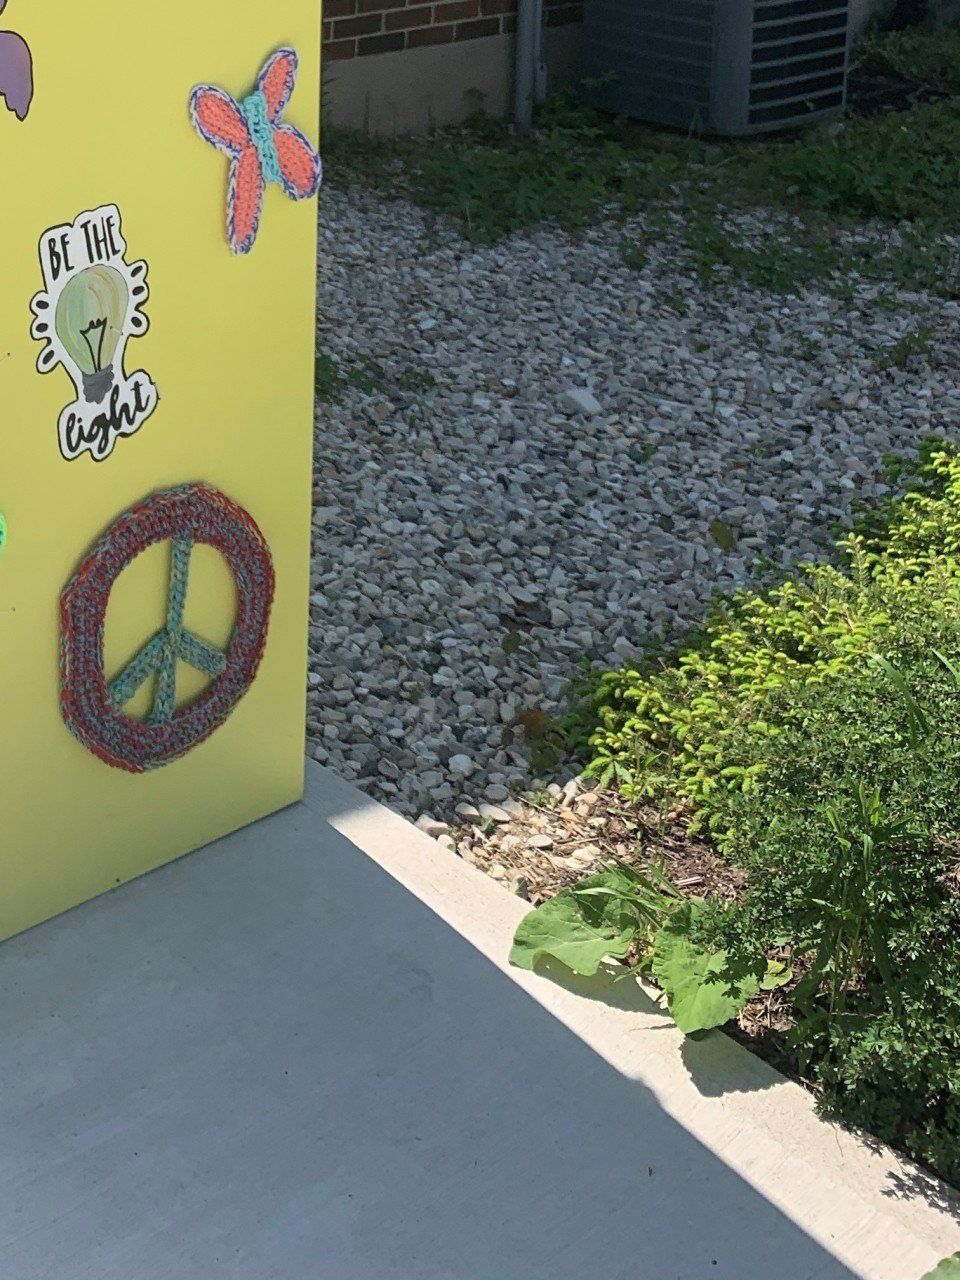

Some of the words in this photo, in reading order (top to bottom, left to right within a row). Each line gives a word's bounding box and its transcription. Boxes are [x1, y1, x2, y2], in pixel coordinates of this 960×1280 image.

[48, 232, 75, 281] BE
[80, 215, 121, 264] THE
[65, 380, 151, 455] light
